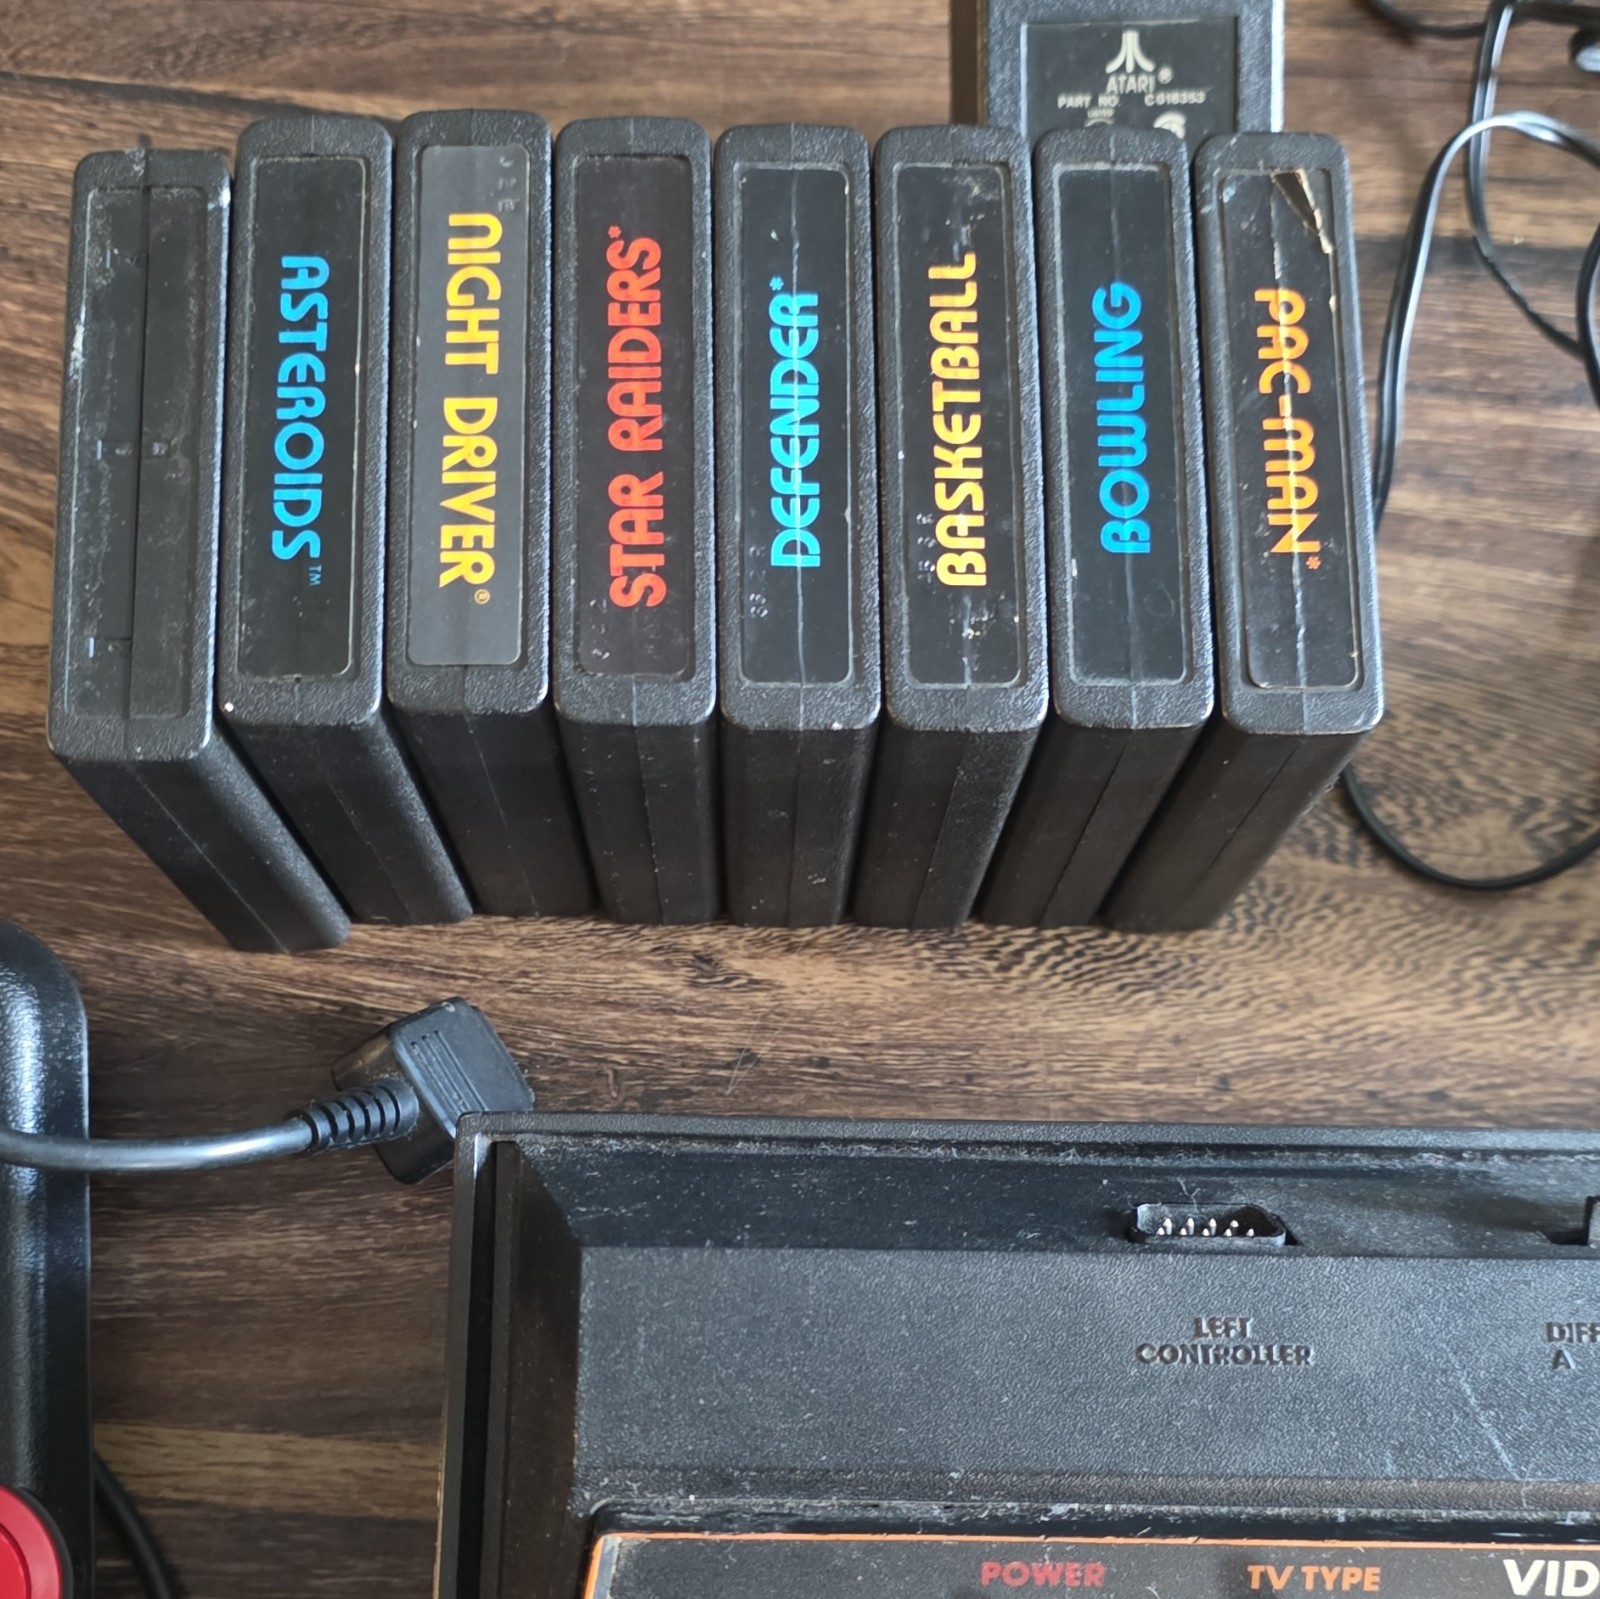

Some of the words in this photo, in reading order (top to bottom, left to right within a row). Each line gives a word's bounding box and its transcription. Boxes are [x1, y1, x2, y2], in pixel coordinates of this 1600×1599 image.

[1057, 93, 1091, 109] PART
[445, 212, 503, 375] NIGHT
[928, 252, 988, 587] BASKETBALL
[1092, 281, 1151, 553] BOWLING
[608, 471, 667, 608] STAR
[1194, 1316, 1253, 1339] LEFT
[1135, 1343, 1316, 1366] CONTROLLER
[1551, 1349, 1576, 1370] A
[980, 1560, 1106, 1588] POWER
[1247, 1564, 1295, 1590] TV
[1301, 1565, 1381, 1592] TYPE
[1502, 1558, 1600, 1597] VID
